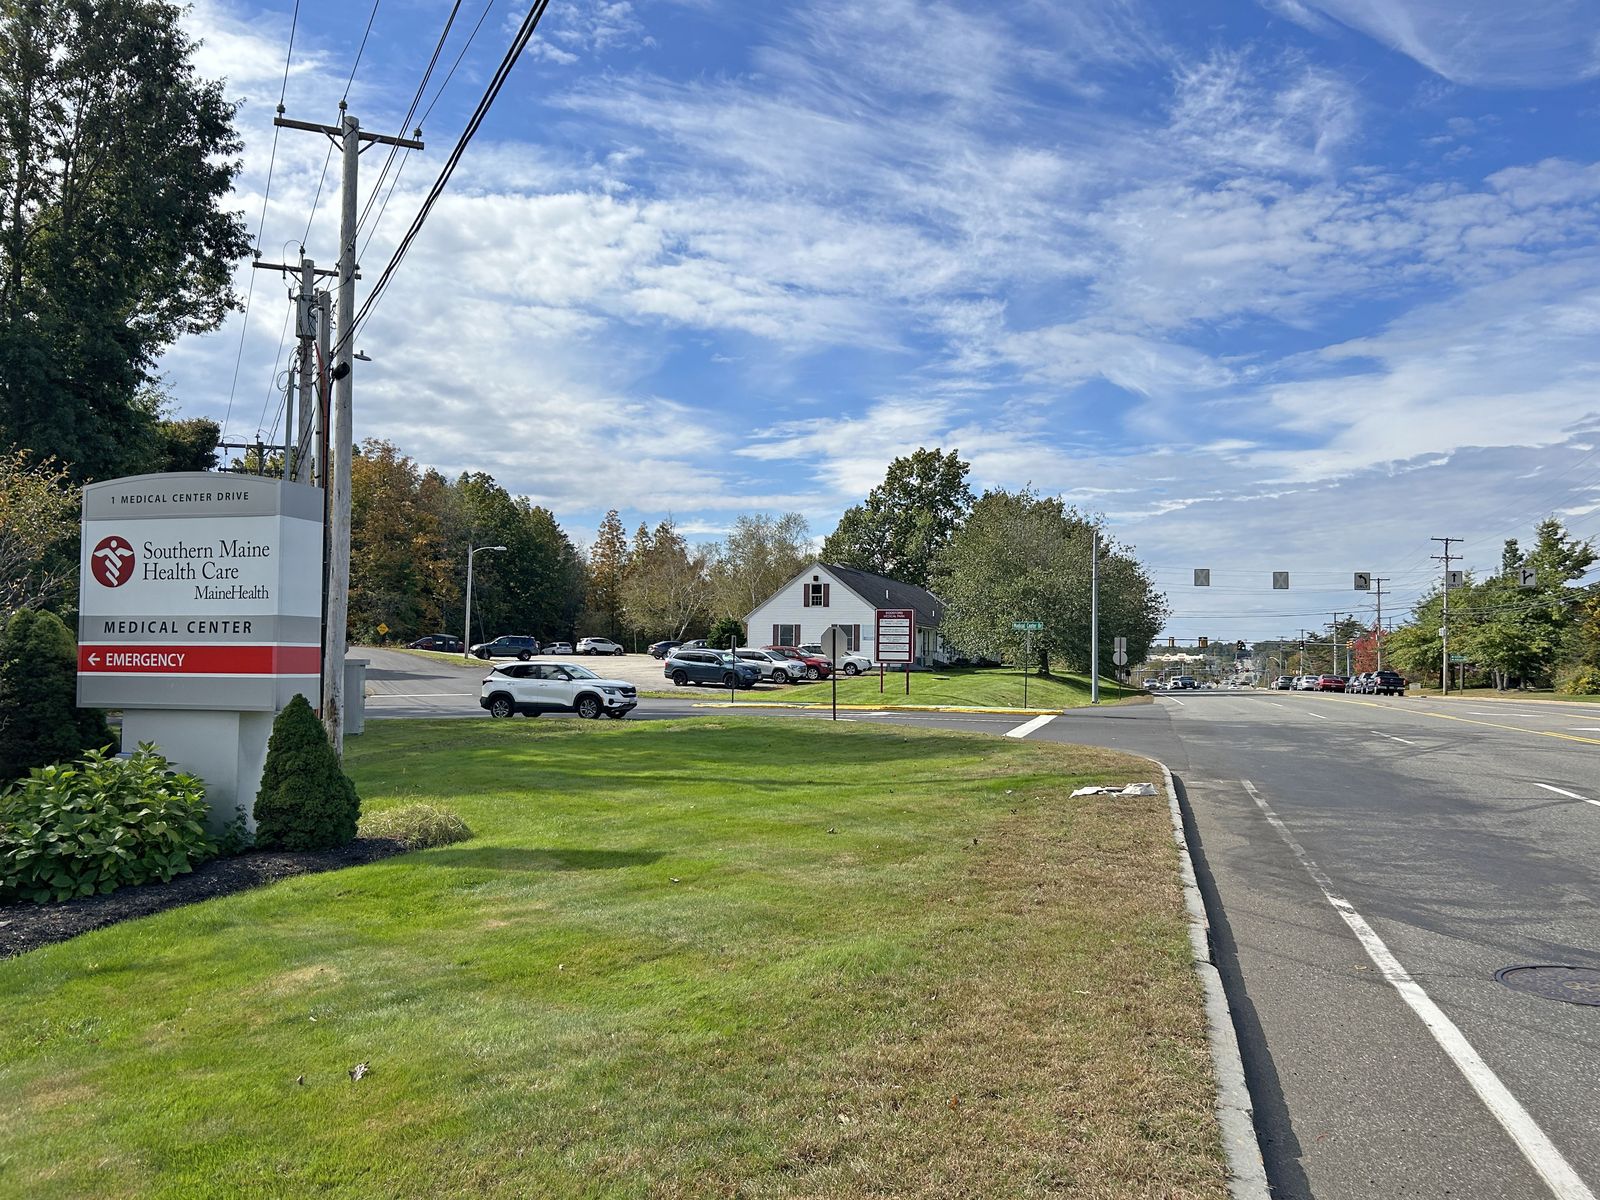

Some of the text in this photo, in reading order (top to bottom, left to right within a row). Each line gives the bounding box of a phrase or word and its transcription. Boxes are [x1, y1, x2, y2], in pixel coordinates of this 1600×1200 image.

[121, 494, 167, 504] MEDICAL
[172, 492, 212, 503] CENTER
[217, 491, 249, 502] DRIVE
[143, 540, 270, 559] Southern Maine
[143, 561, 239, 580] Health Care
[194, 585, 269, 600] MaineHealth
[104, 621, 253, 634] MEDICAL CENTER
[105, 653, 185, 667] EMERGENCY
